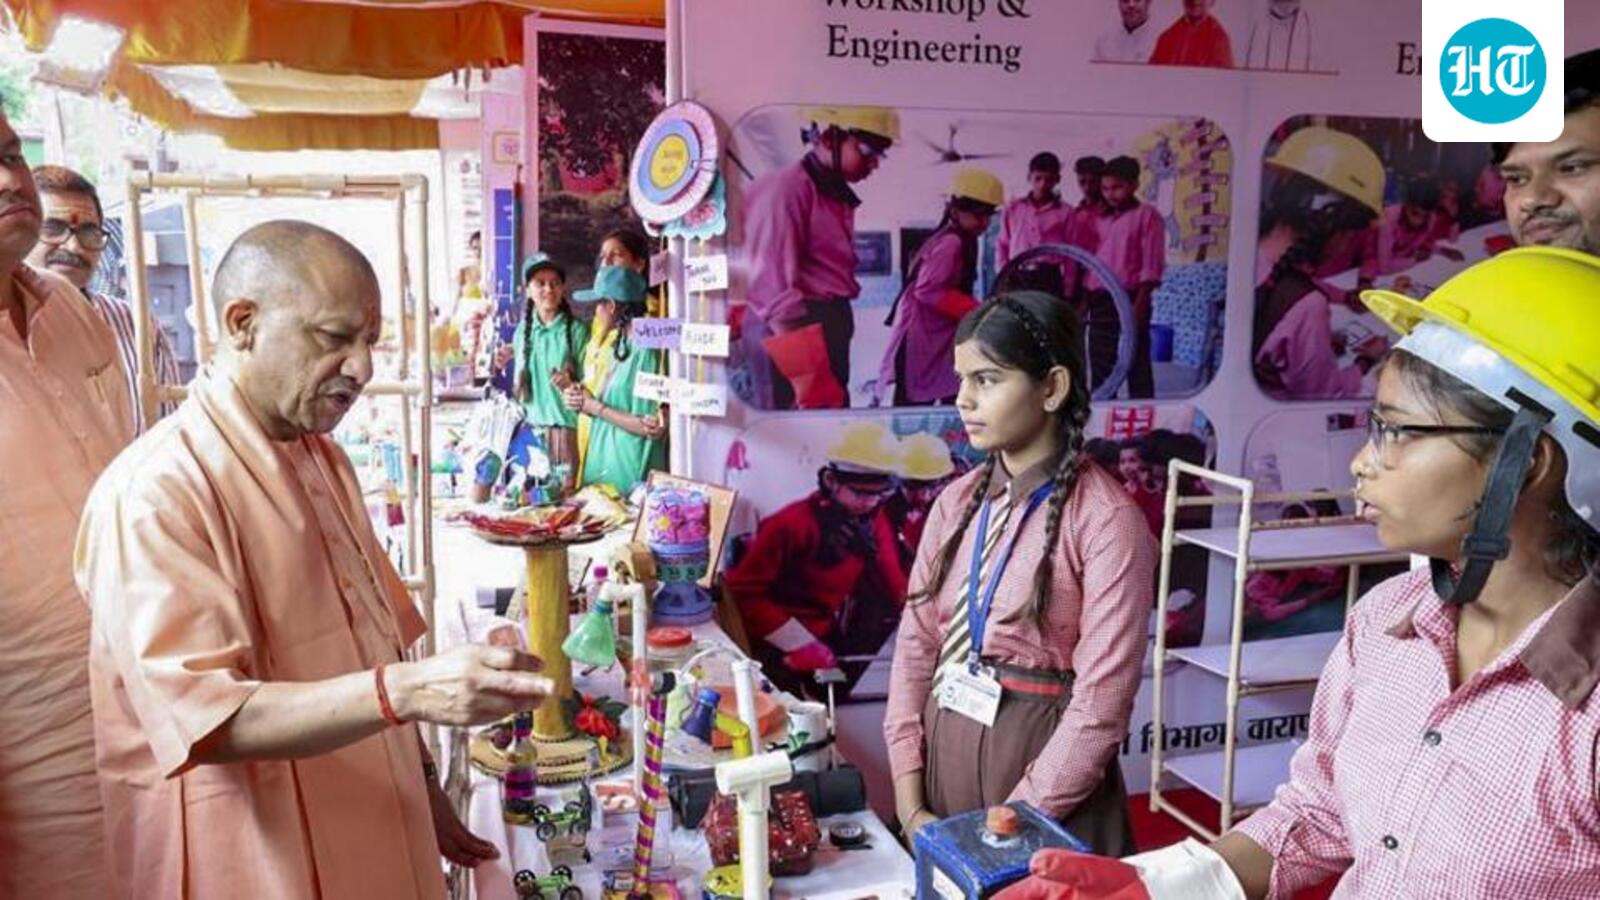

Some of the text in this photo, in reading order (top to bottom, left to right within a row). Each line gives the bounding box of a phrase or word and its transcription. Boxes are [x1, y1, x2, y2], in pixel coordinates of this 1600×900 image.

[826, 0, 1031, 22] orsop &
[826, 24, 1022, 73] Engineering
[1396, 42, 1422, 75] E
